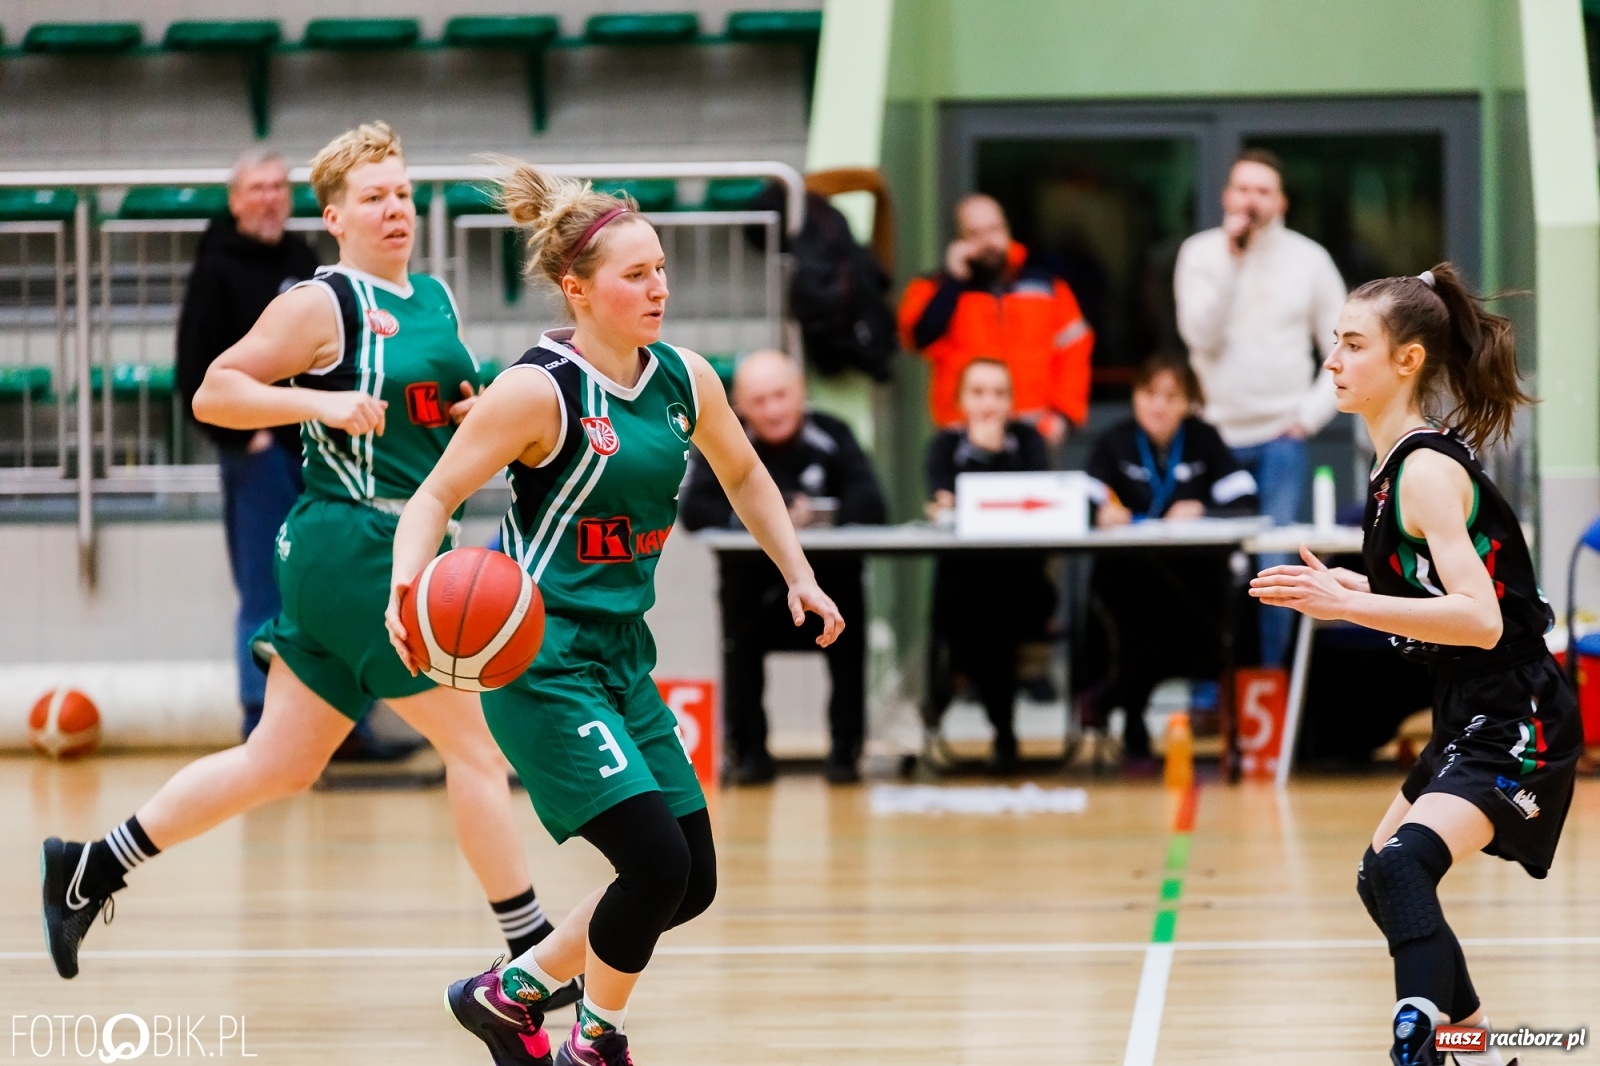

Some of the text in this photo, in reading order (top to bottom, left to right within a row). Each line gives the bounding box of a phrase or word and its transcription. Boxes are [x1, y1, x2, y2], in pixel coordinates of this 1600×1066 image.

[582, 522, 631, 557] K
[1237, 680, 1277, 750] 5
[577, 720, 628, 778] 3
